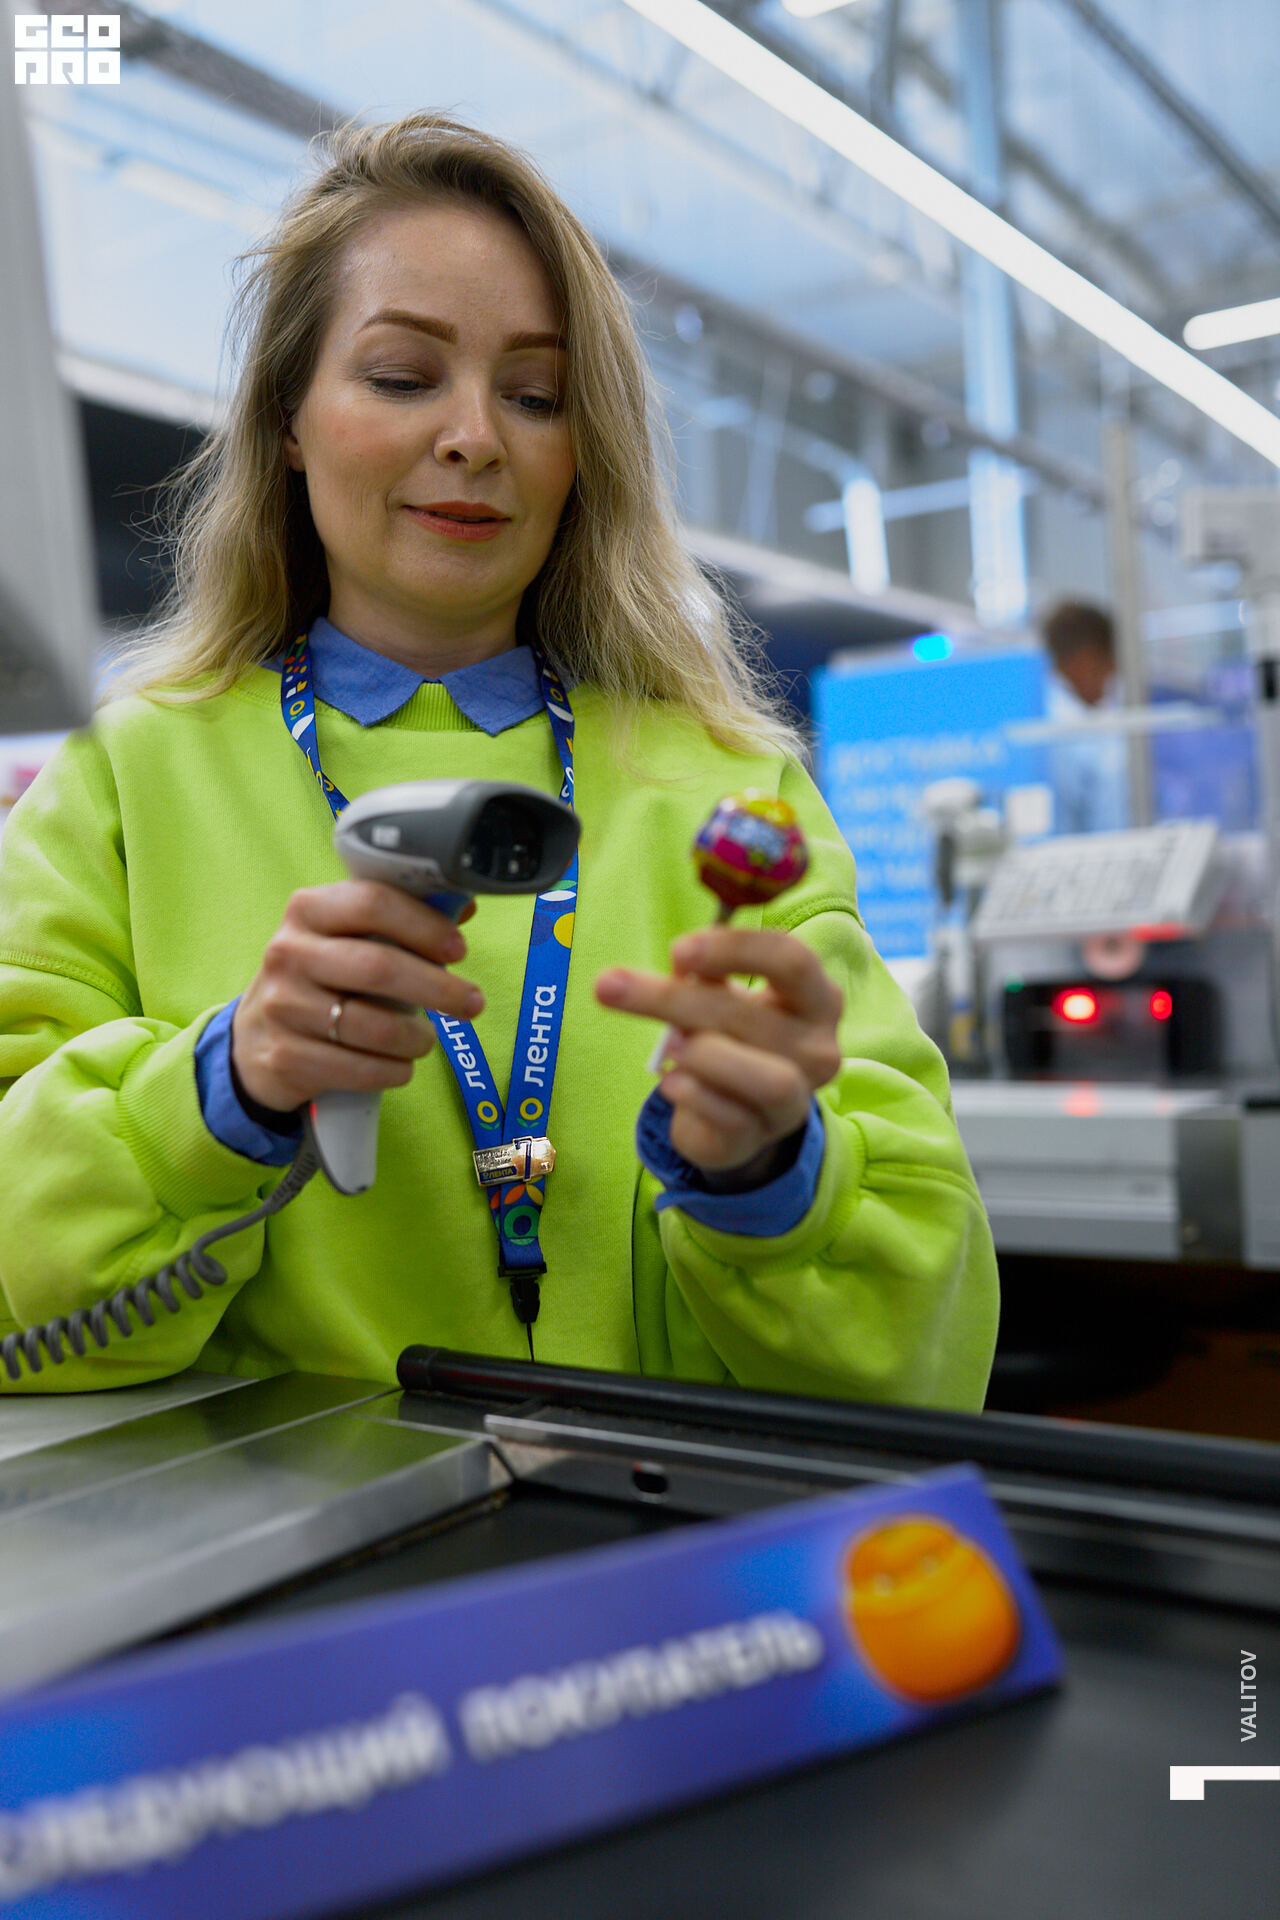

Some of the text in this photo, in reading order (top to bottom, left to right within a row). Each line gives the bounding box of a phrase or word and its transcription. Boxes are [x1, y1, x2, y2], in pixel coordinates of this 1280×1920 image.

[436, 1010, 486, 1090] лент
[524, 985, 557, 1087] лента
[461, 1613, 824, 1763] ПОКУПАТЕЛЬ
